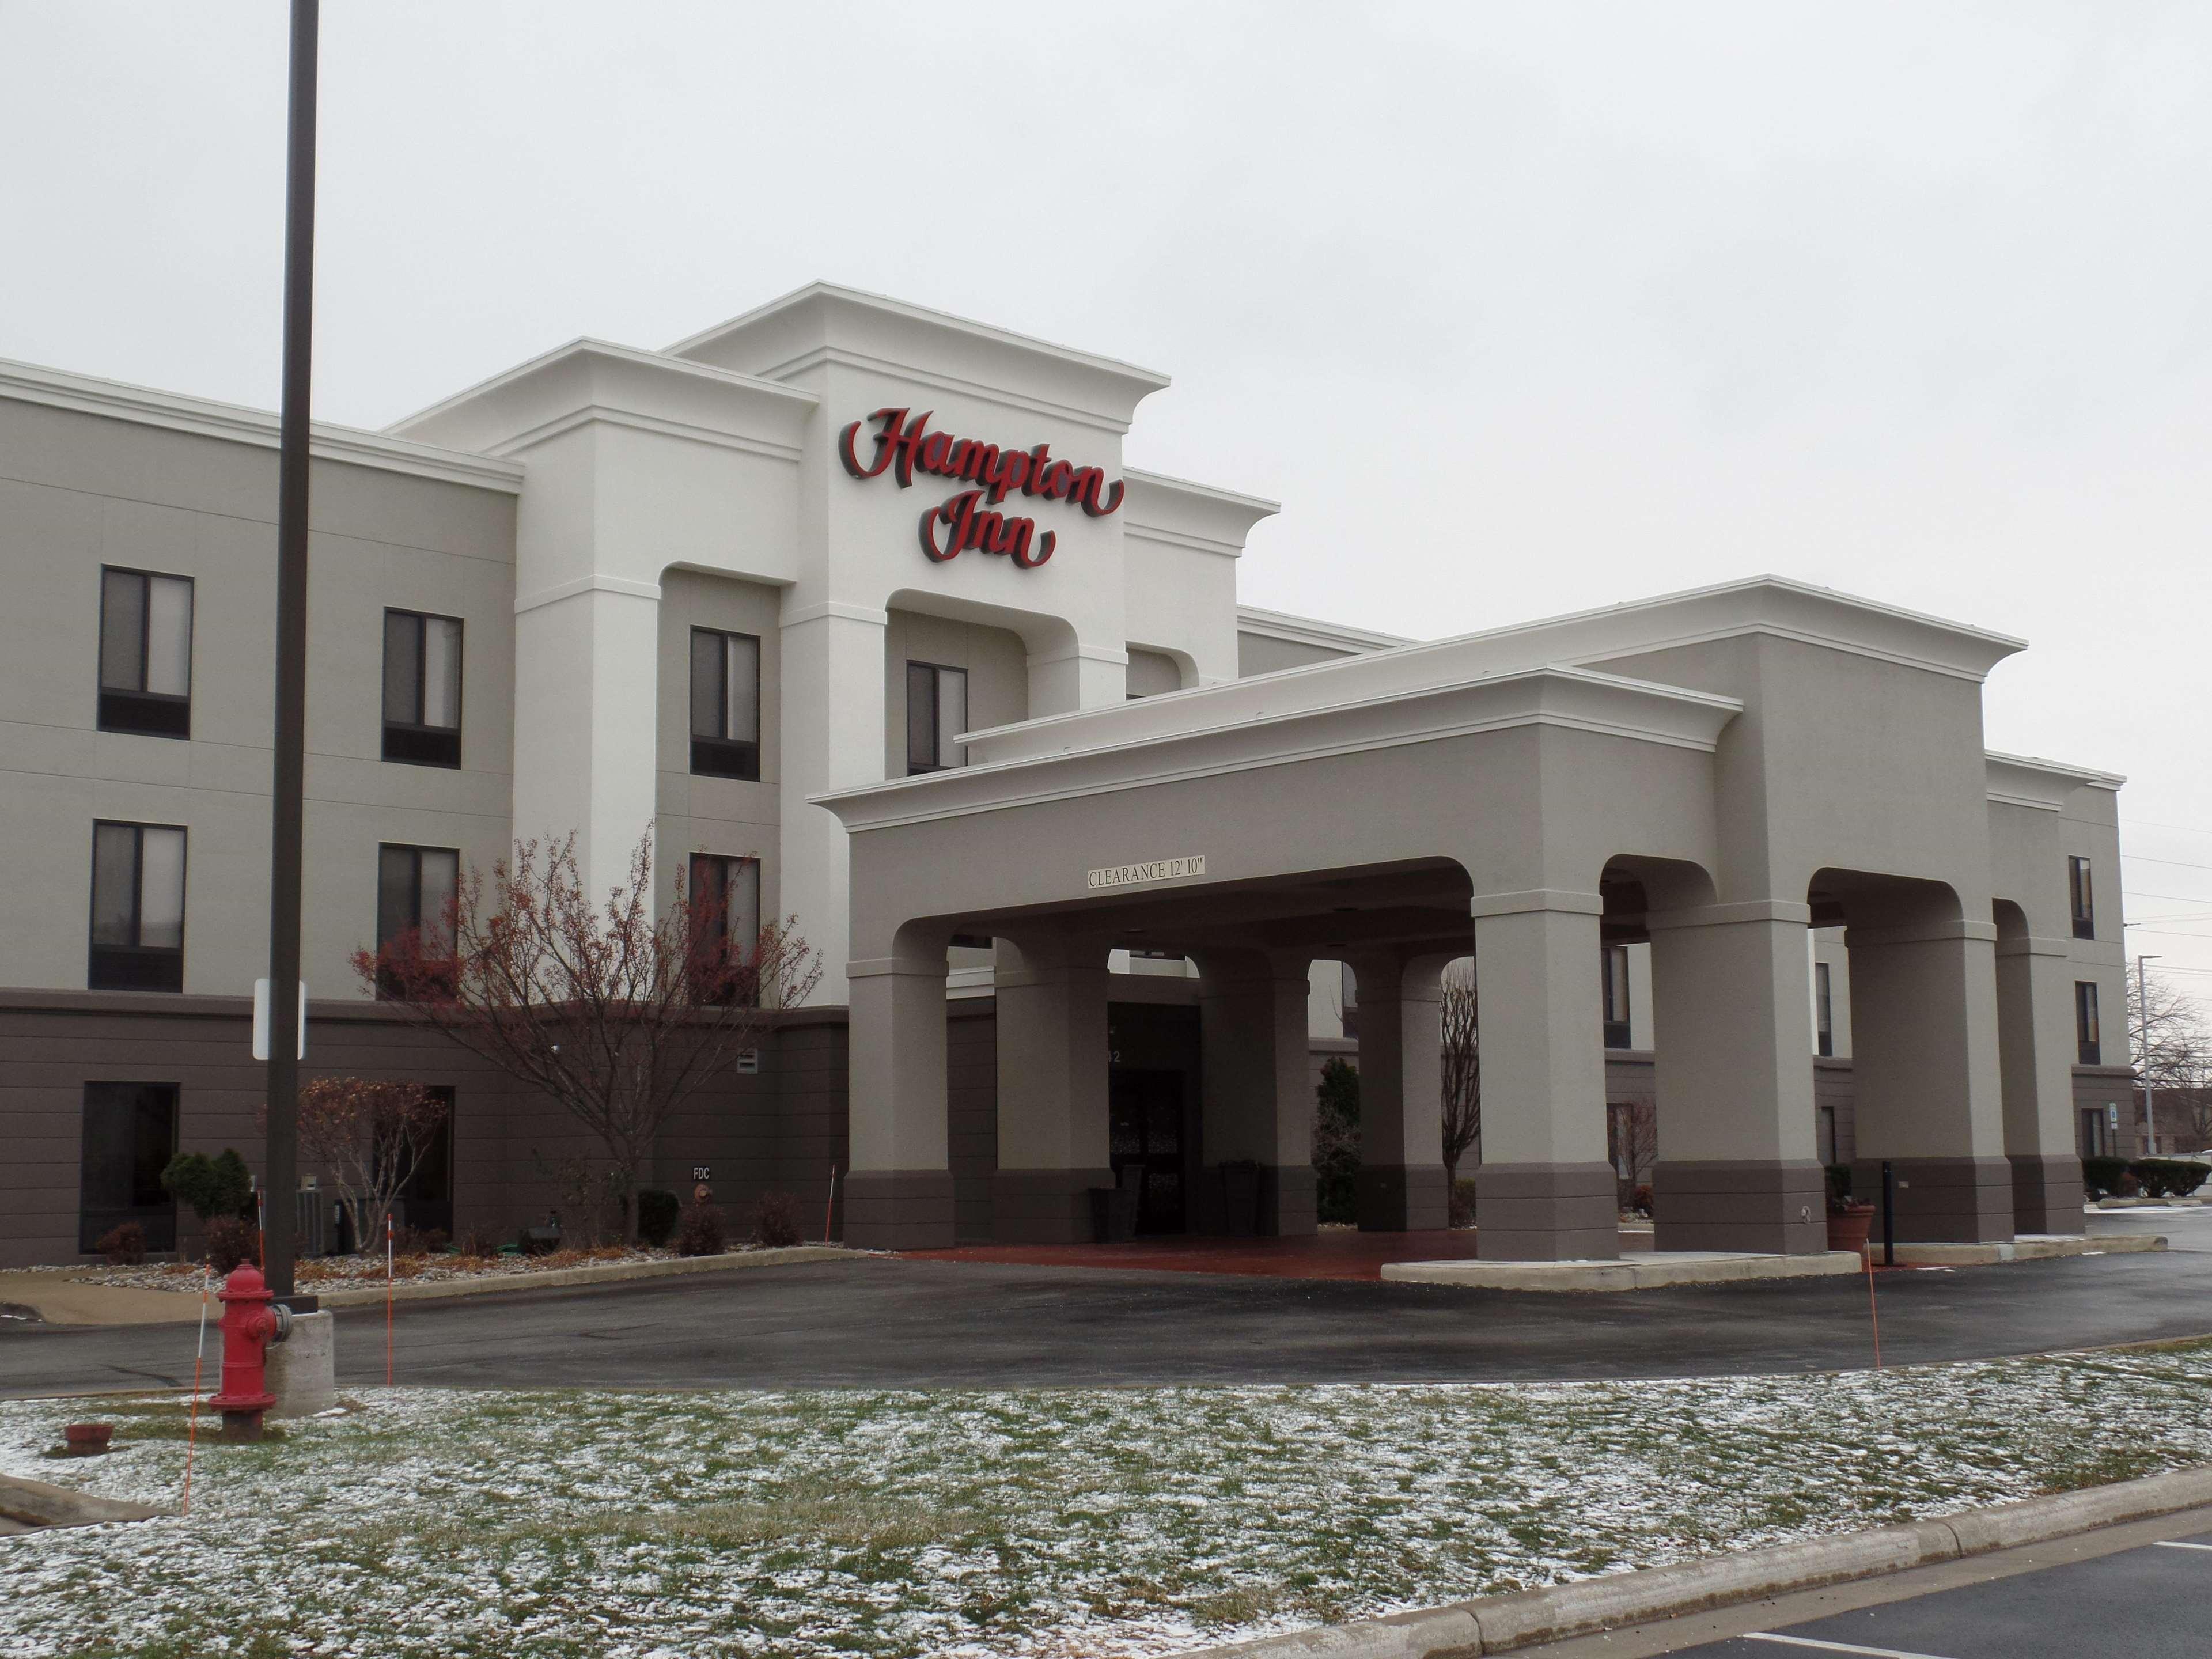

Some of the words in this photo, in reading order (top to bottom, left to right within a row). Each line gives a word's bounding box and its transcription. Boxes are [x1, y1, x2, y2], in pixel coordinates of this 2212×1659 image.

[838, 407, 1124, 517] Hampton
[919, 490, 1056, 569] Inn
[1089, 862, 1165, 887] CLEARANCE
[1170, 860, 1183, 876] 12'
[1187, 857, 1202, 874] 10"
[694, 1168, 709, 1179] FDC
